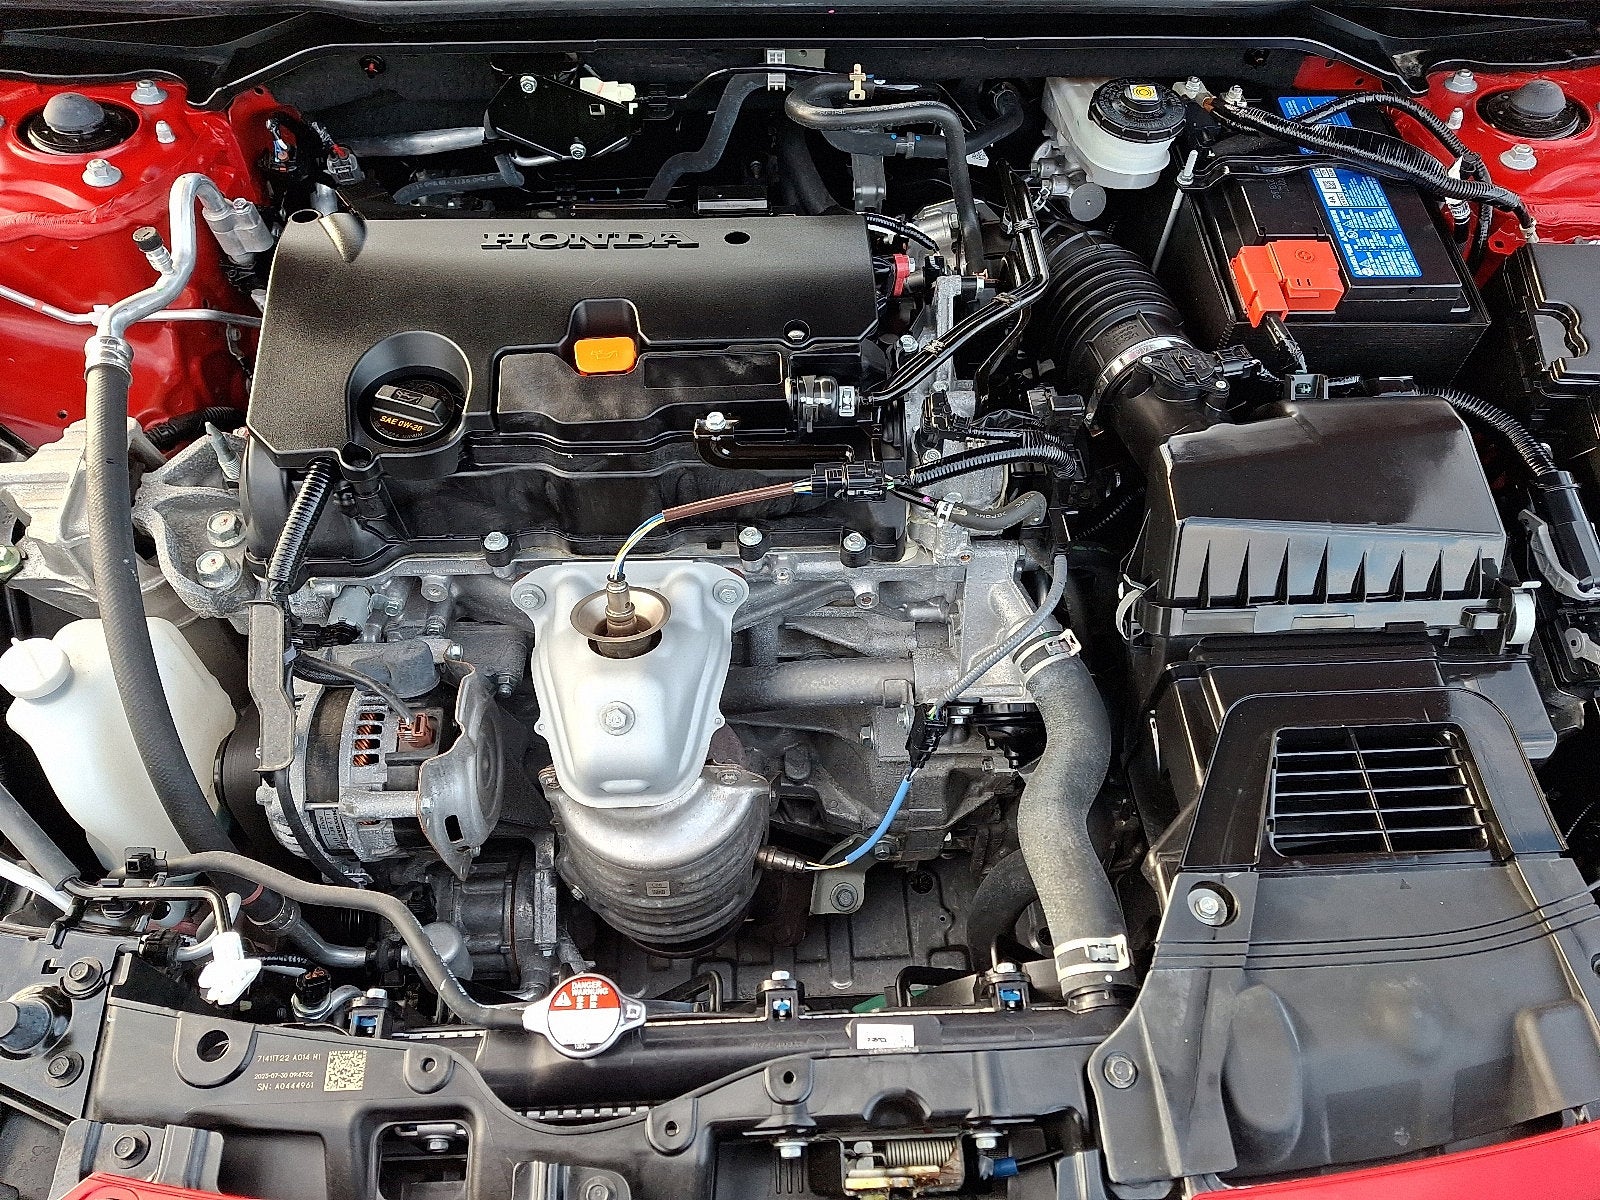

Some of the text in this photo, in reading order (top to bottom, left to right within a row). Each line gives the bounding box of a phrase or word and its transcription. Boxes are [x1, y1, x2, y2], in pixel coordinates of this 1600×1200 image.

[481, 232, 699, 249] HONDA
[380, 416, 423, 431] SAE 0W-20
[257, 1082, 314, 1091] SN: A0444961
